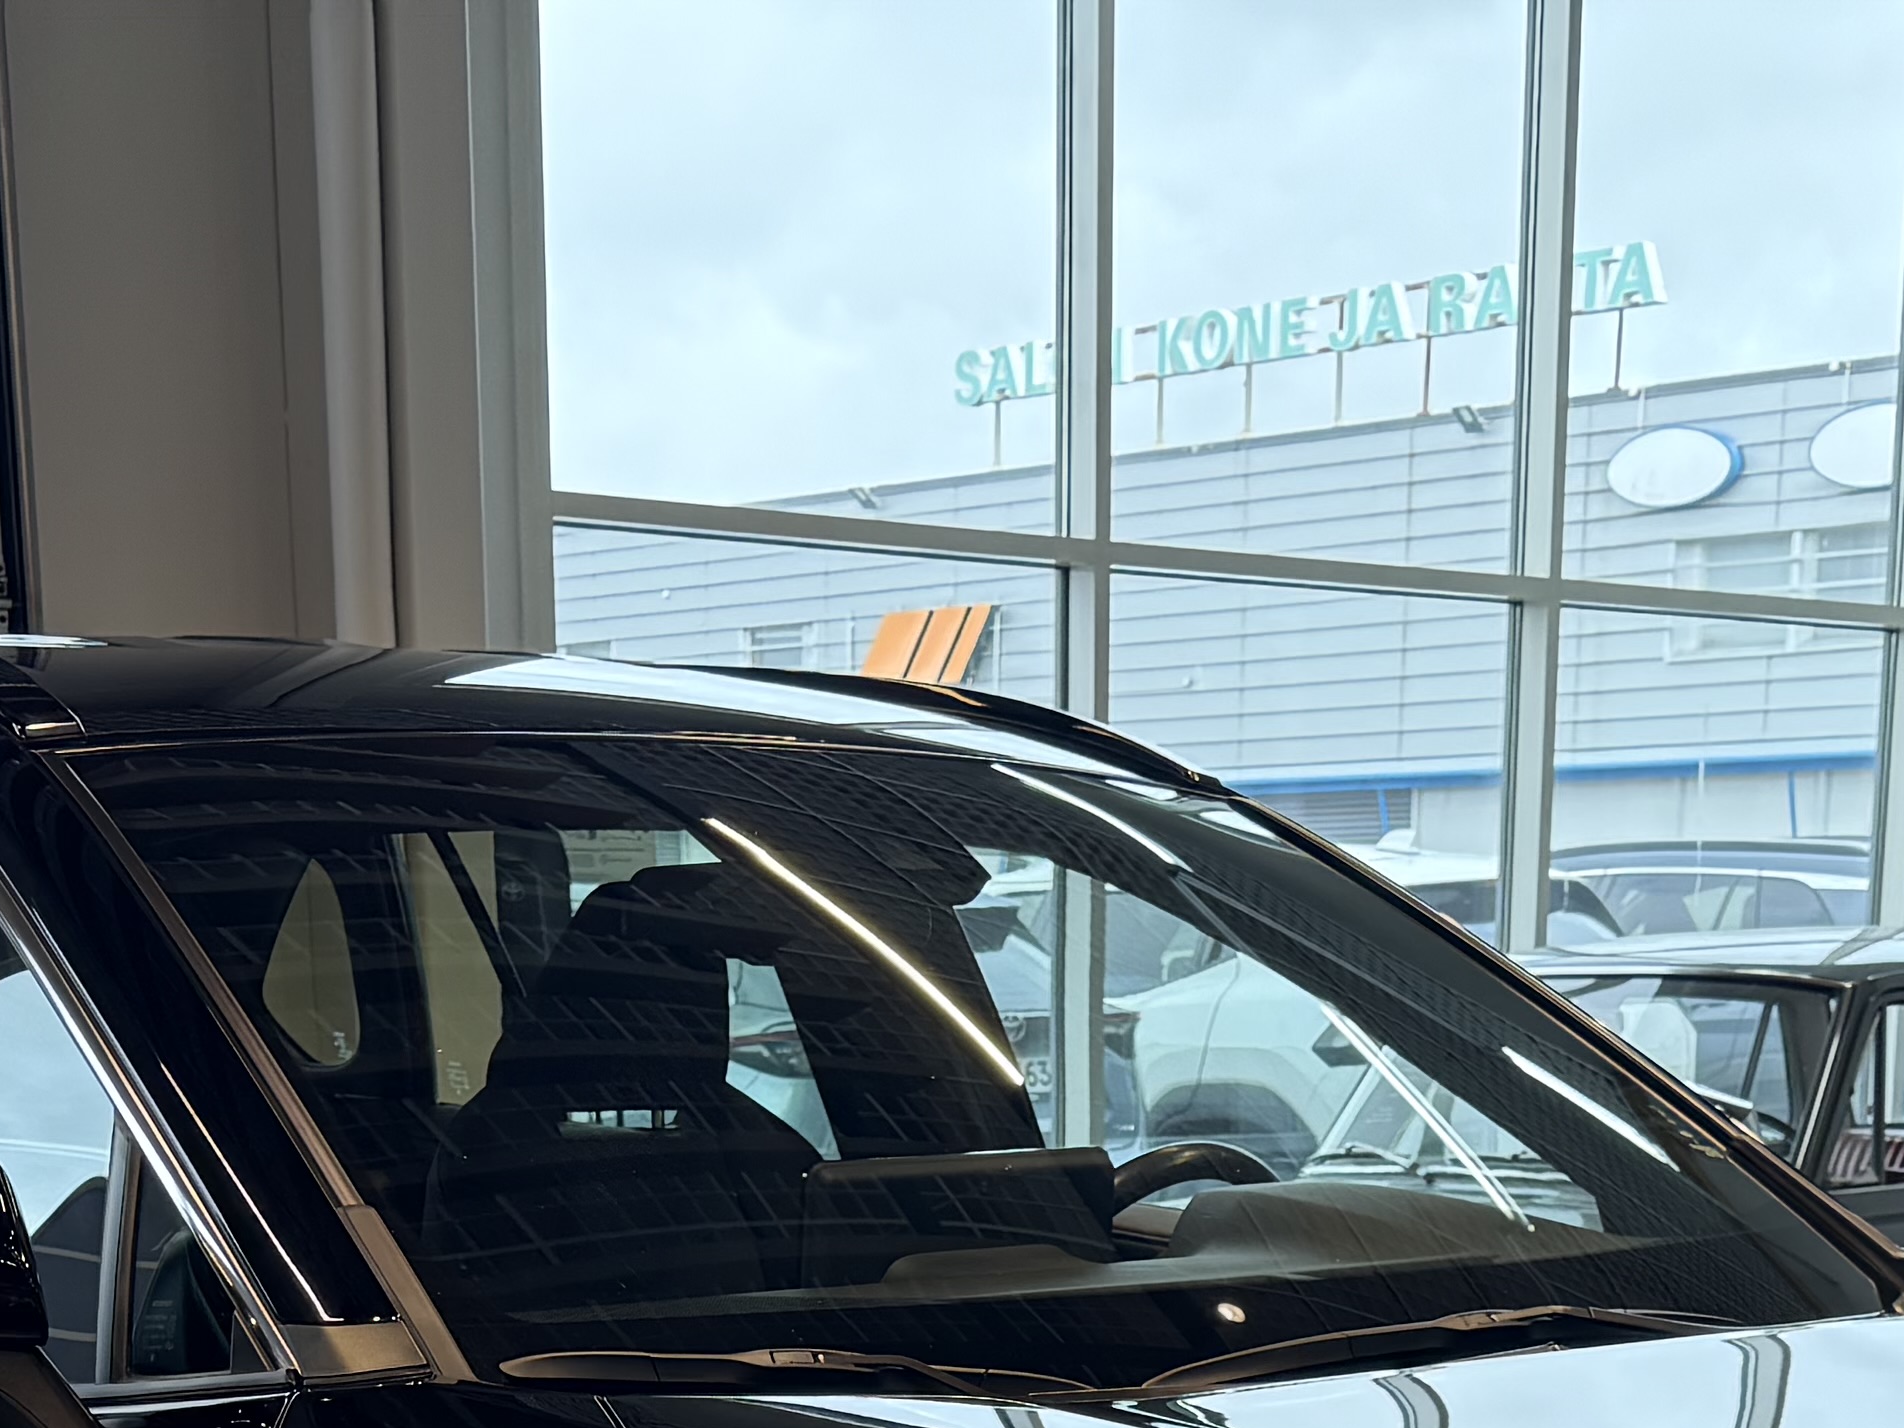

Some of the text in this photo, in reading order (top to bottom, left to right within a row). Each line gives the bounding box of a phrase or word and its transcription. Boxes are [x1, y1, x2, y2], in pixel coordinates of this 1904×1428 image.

[954, 242, 1663, 406] SAL KONE JA RATA
